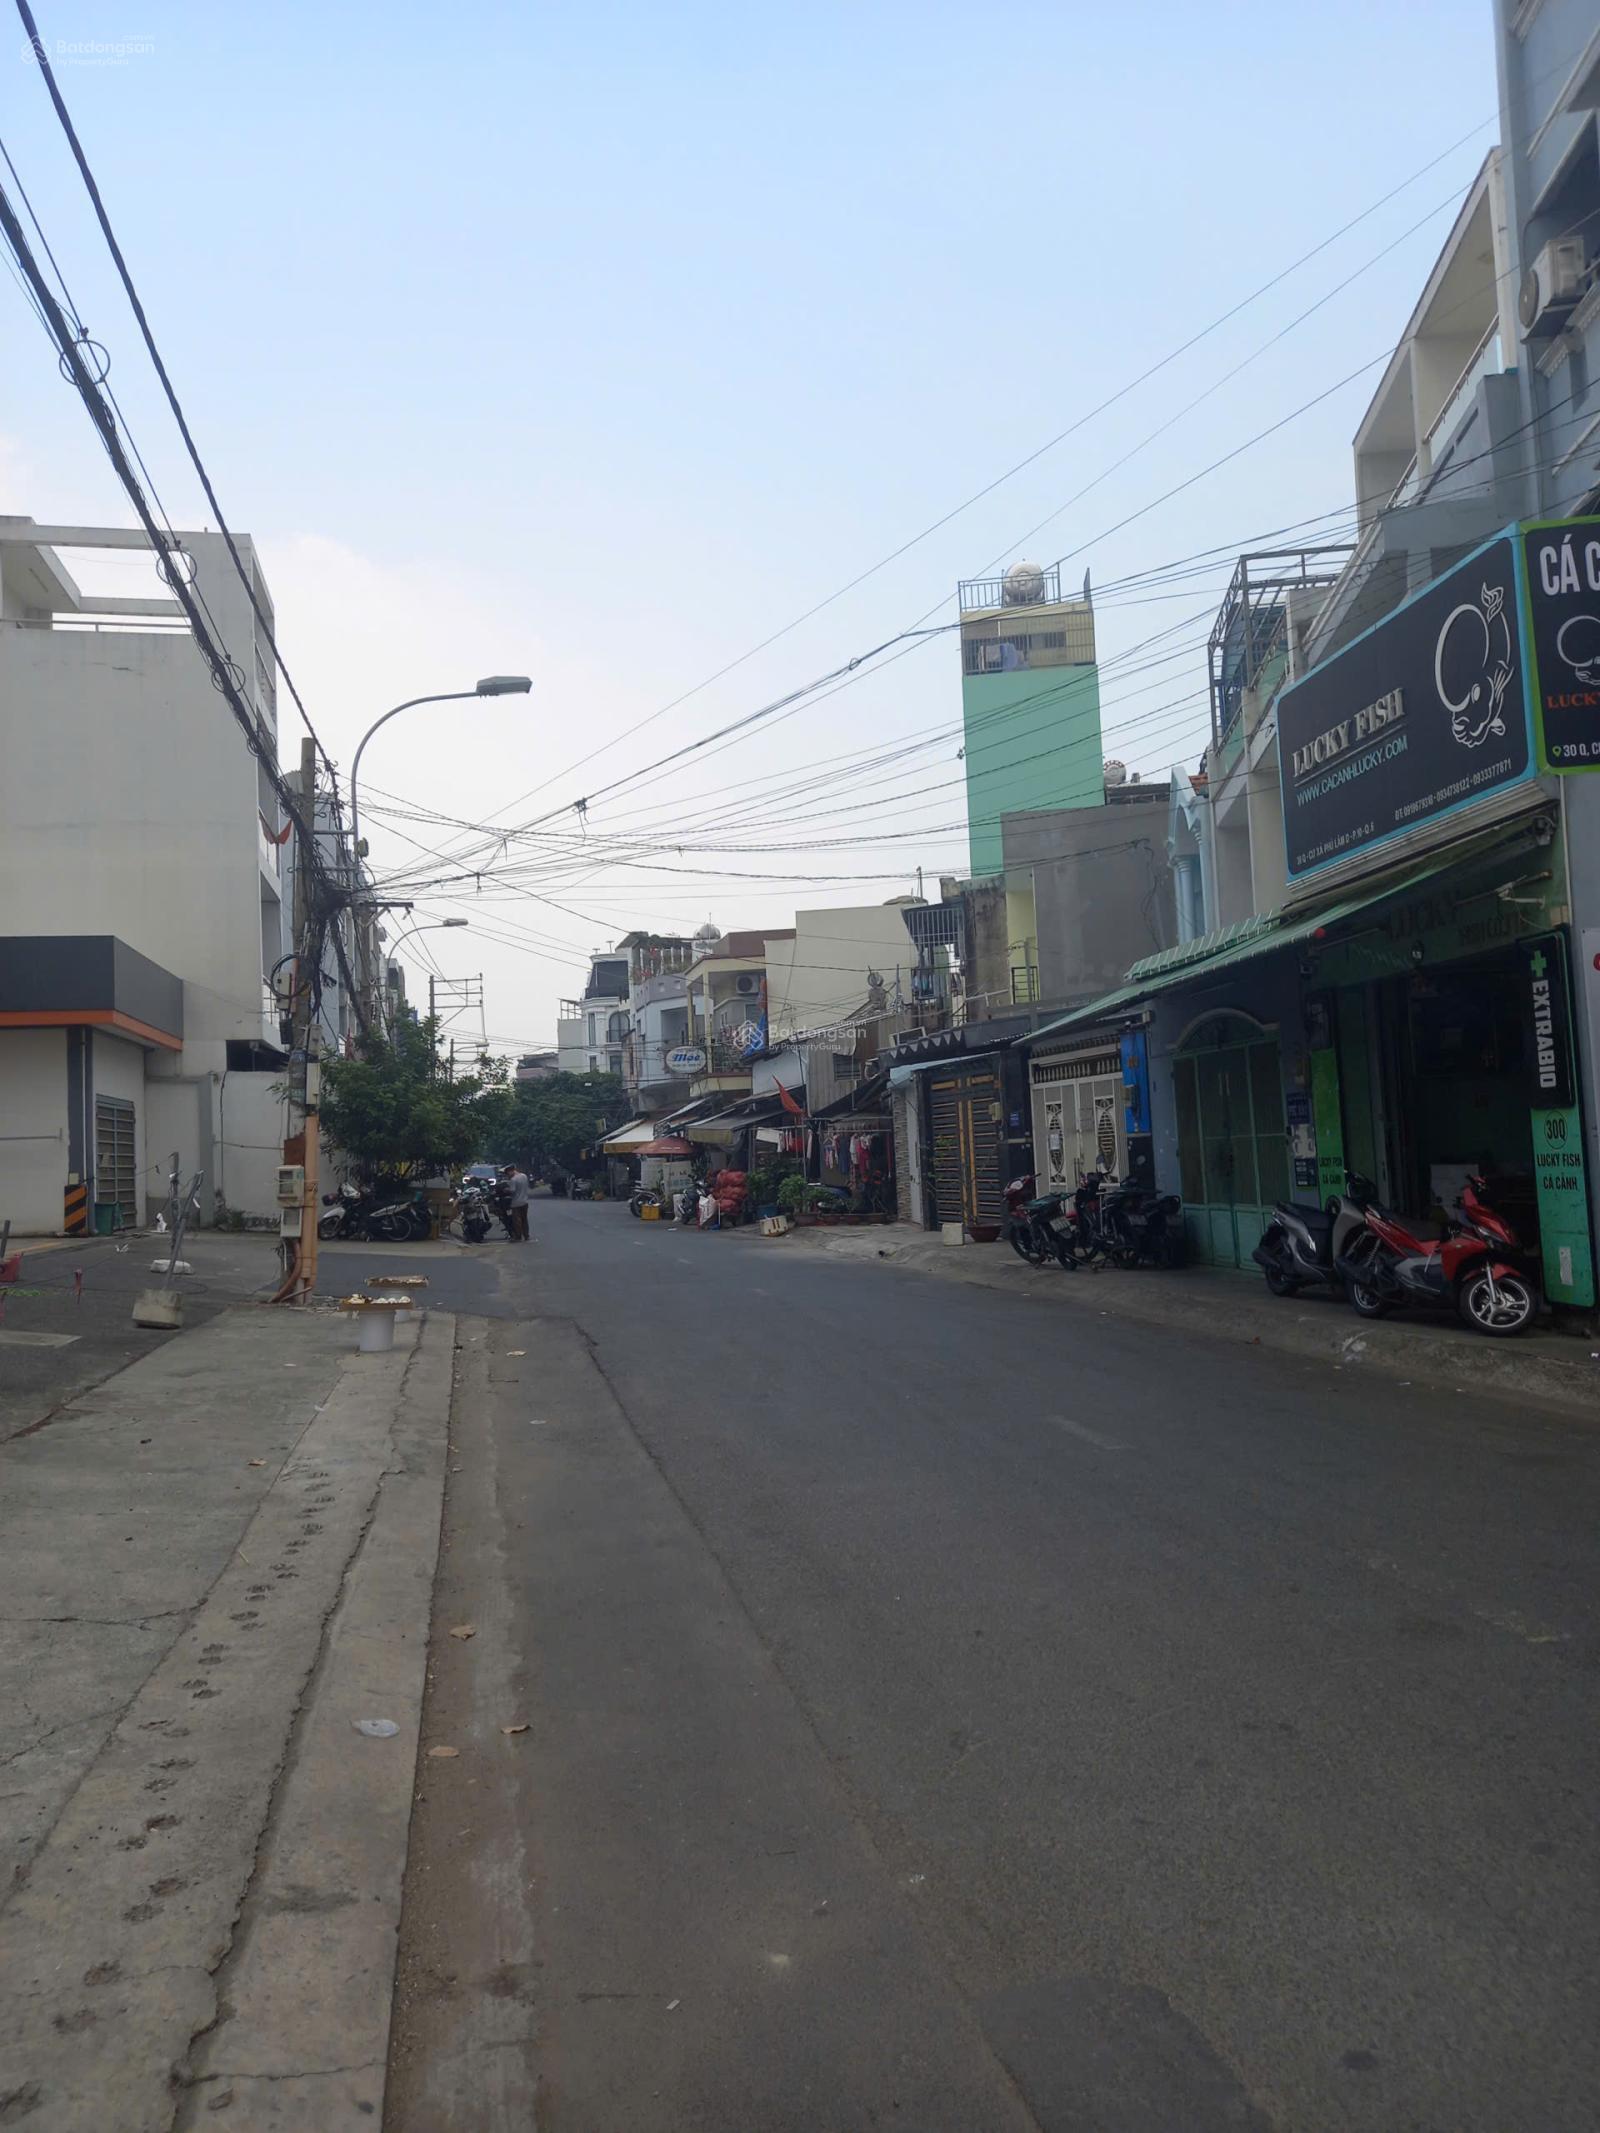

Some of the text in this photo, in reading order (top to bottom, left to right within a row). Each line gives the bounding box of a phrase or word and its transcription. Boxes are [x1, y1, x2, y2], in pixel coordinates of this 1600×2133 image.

[1540, 534, 1580, 596] CÁ
[1293, 688, 1405, 778] LUCKY FISH
[1563, 744, 1577, 757] 30
[1537, 1153, 1580, 1167] LUCKY FISH
